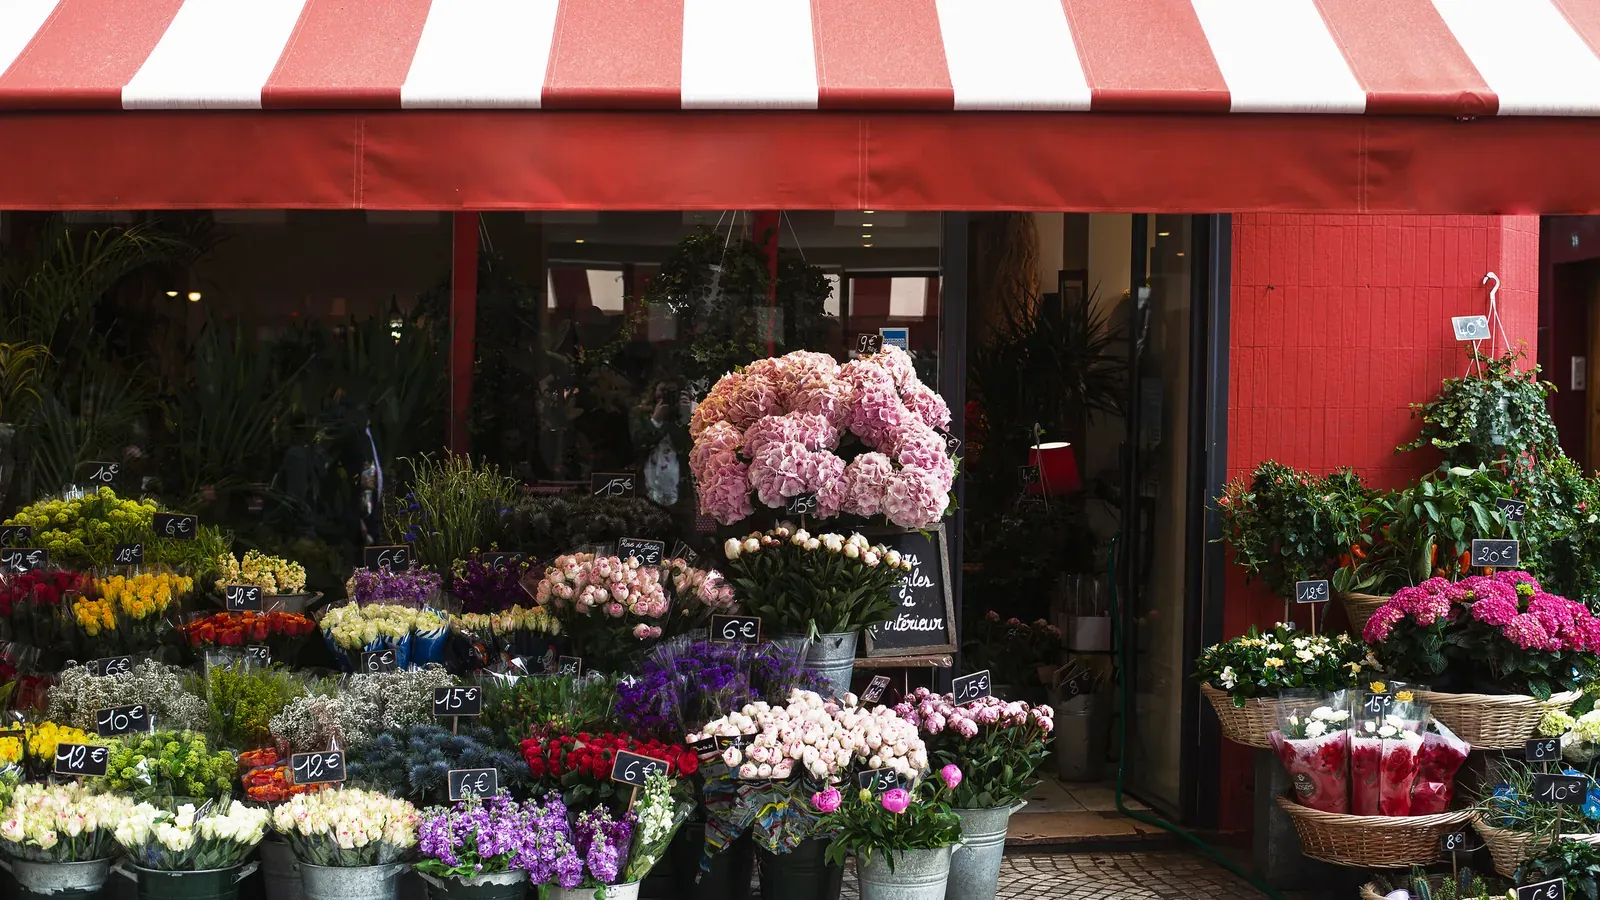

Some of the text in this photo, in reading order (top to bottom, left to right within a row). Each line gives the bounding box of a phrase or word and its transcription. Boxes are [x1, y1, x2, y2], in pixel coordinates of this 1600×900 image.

[1457, 317, 1485, 336] 40€
[89, 463, 119, 482] 10€
[594, 478, 633, 496] 15€
[789, 494, 816, 513] 15€
[165, 517, 192, 534] 6€
[2, 550, 42, 569] 12€
[116, 544, 142, 562] 12€
[377, 549, 405, 567] 6€
[1478, 546, 1512, 562] 20€
[890, 567, 935, 598] giles
[1300, 583, 1326, 600] 12€
[228, 586, 258, 606] 12€
[902, 588, 916, 607] à
[722, 620, 756, 639] 6€
[873, 613, 944, 632] intérieur
[106, 658, 129, 676] 6€
[368, 651, 393, 670] 6€
[958, 675, 988, 699] 15€
[435, 688, 478, 711] 15€
[1364, 695, 1391, 712] 15€
[99, 705, 143, 730] 10€
[57, 745, 106, 769] 12€
[1535, 740, 1556, 757] 8€
[294, 753, 340, 779] 12€
[624, 760, 657, 781] 6€
[460, 772, 490, 793] 6€
[1541, 781, 1581, 800] 10€
[1446, 833, 1463, 850] 8€
